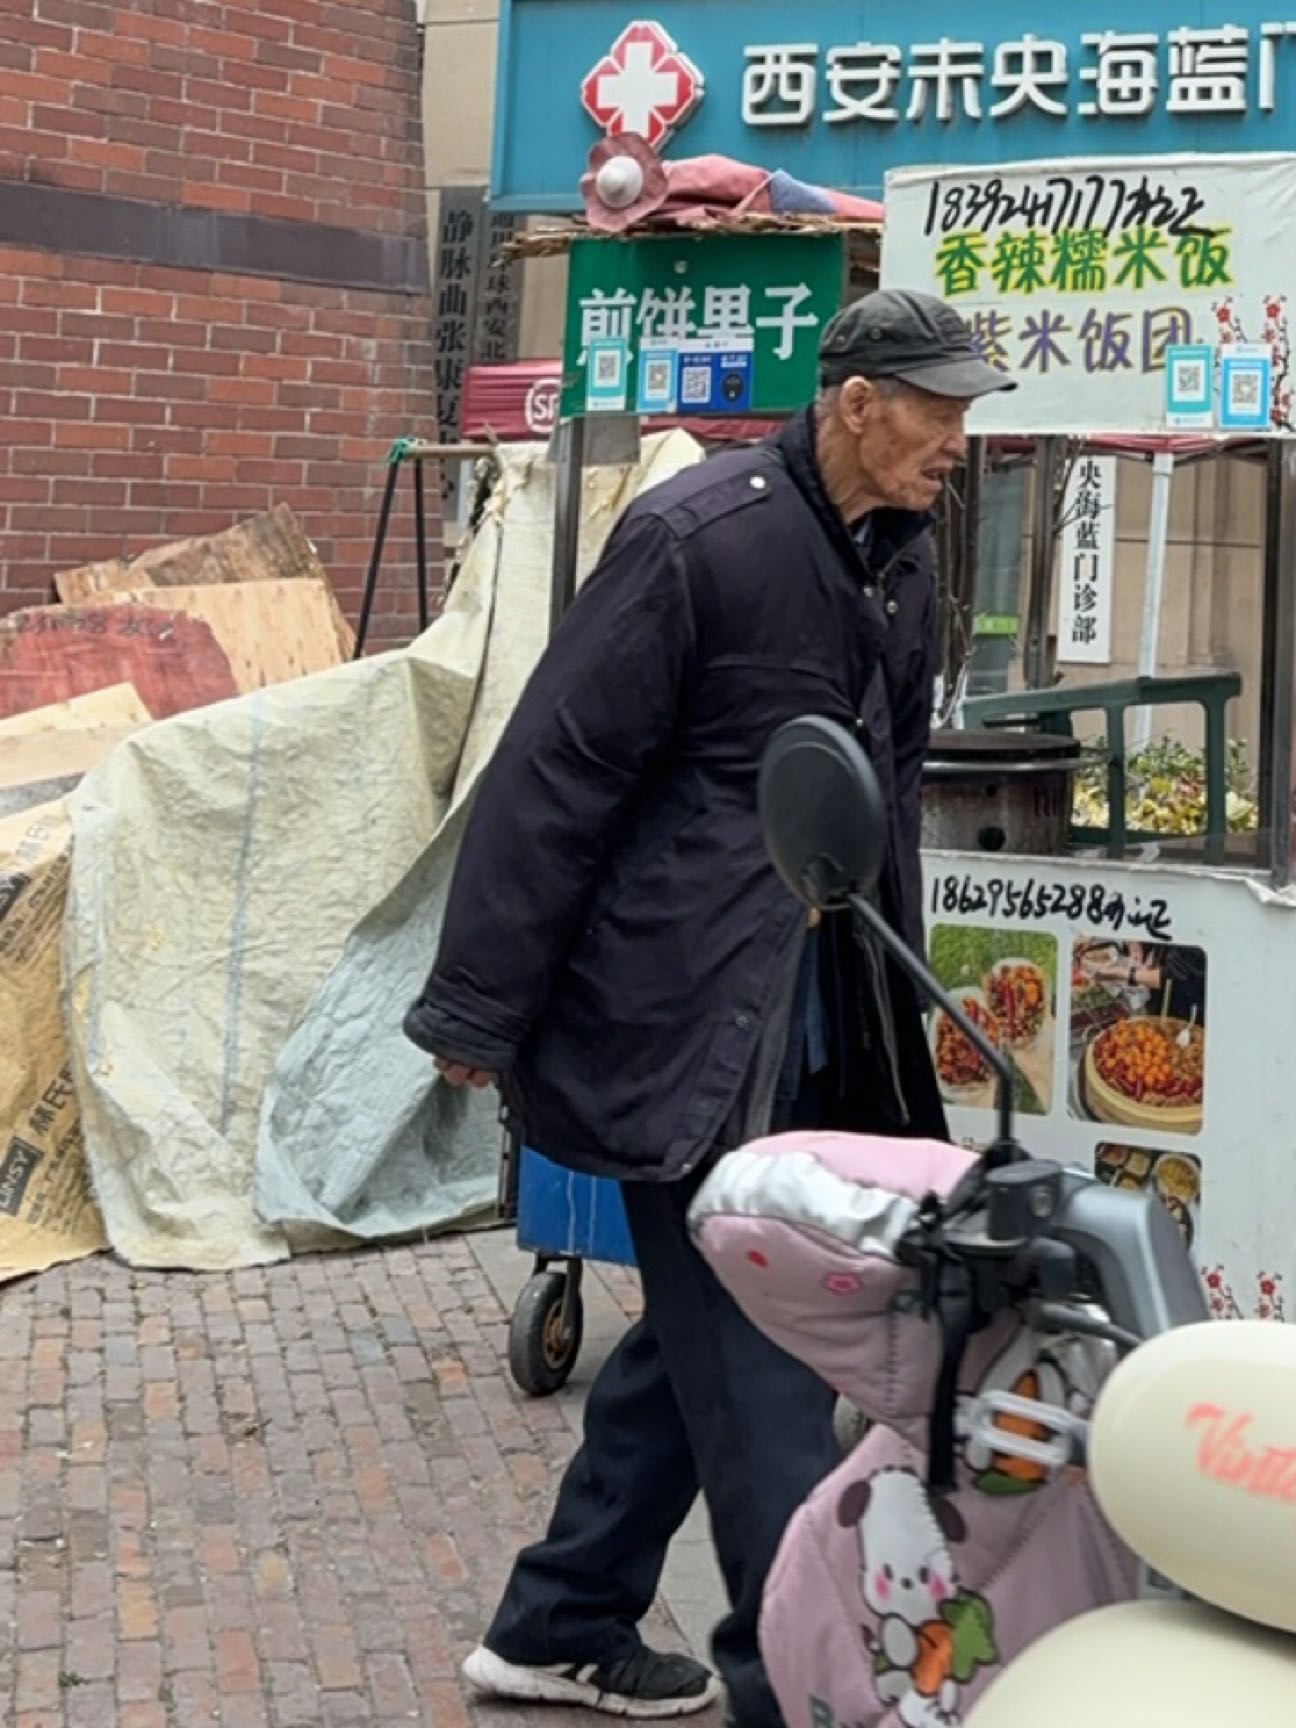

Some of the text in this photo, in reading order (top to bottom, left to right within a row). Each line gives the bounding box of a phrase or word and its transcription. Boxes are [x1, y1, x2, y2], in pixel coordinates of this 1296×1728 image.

[935, 225, 1233, 297] 香辣糯米饭
[576, 282, 819, 367] 煎饼果子
[966, 305, 1193, 374] 紫米饭团
